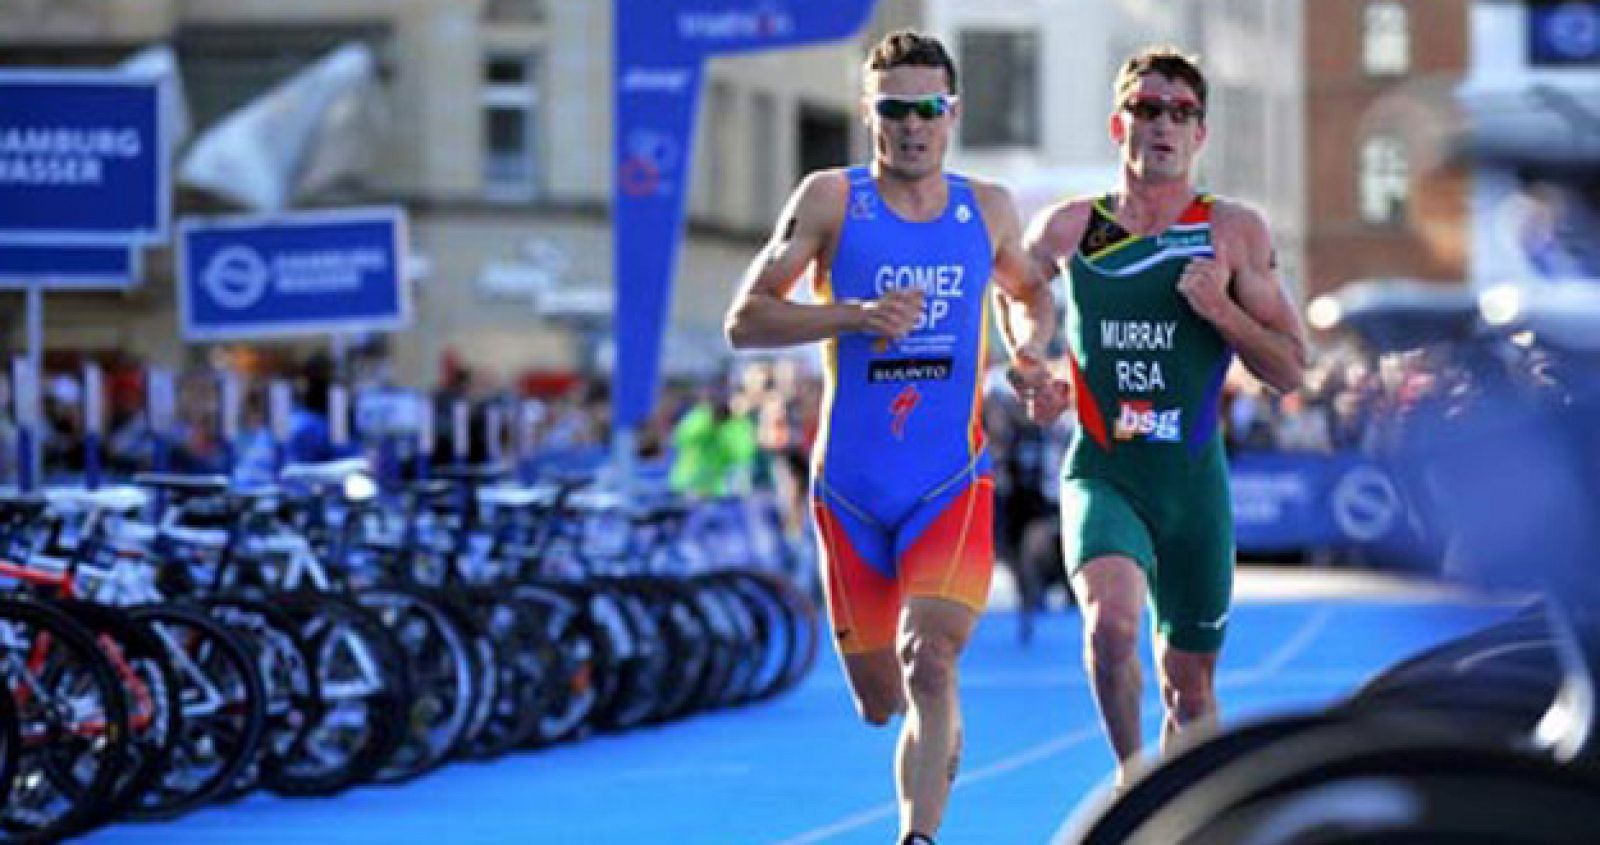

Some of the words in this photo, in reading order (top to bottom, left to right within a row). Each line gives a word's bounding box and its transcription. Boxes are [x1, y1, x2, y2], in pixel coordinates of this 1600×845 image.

[0, 128, 140, 155] AMBURG
[875, 265, 964, 298] GOMEZ
[908, 300, 949, 329] SP
[1101, 320, 1176, 350] MURRAY
[1116, 361, 1165, 391] RSA
[1119, 403, 1181, 440] bsg
